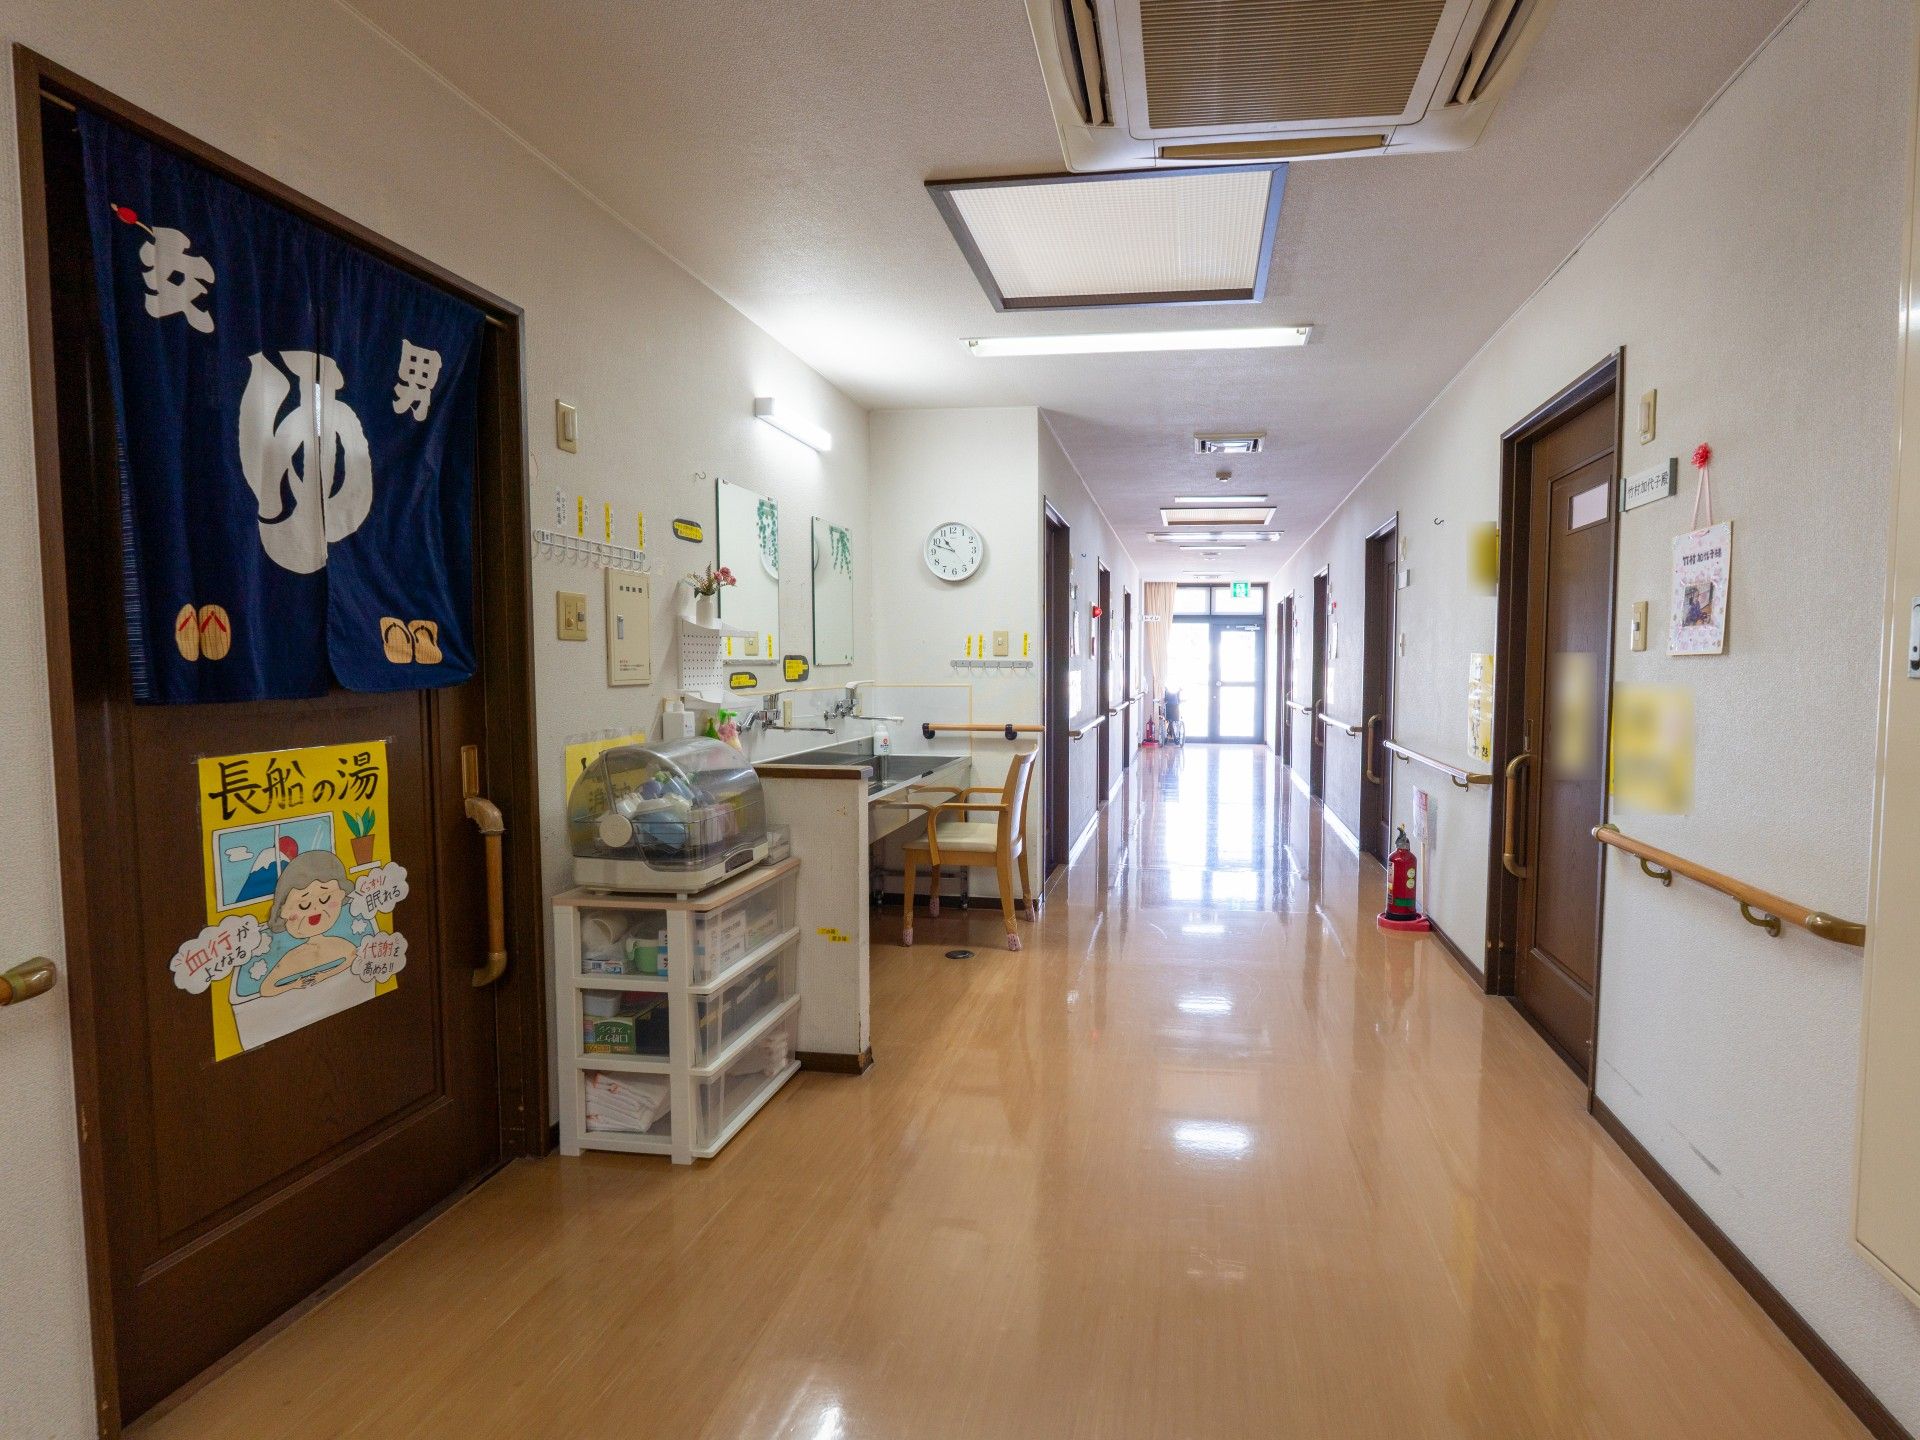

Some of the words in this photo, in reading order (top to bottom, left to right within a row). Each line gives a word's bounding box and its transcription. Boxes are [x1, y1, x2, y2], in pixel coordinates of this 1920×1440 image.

[392, 338, 442, 422] 男
[238, 350, 374, 575] ゆ
[940, 529, 947, 537] 11
[949, 526, 958, 534] 12
[961, 528, 966, 536] 1
[932, 537, 941, 545] 10
[968, 536, 975, 544] 2
[930, 547, 937, 556] 9
[971, 546, 977, 554] 3
[934, 558, 940, 566] 8
[969, 556, 975, 565] 4
[942, 565, 948, 573] 7
[951, 567, 958, 575] 6
[961, 564, 968, 573] 5
[207, 750, 380, 821] 長船の湯
[185, 921, 250, 977] 血行が
[204, 946, 247, 983] よくなる
